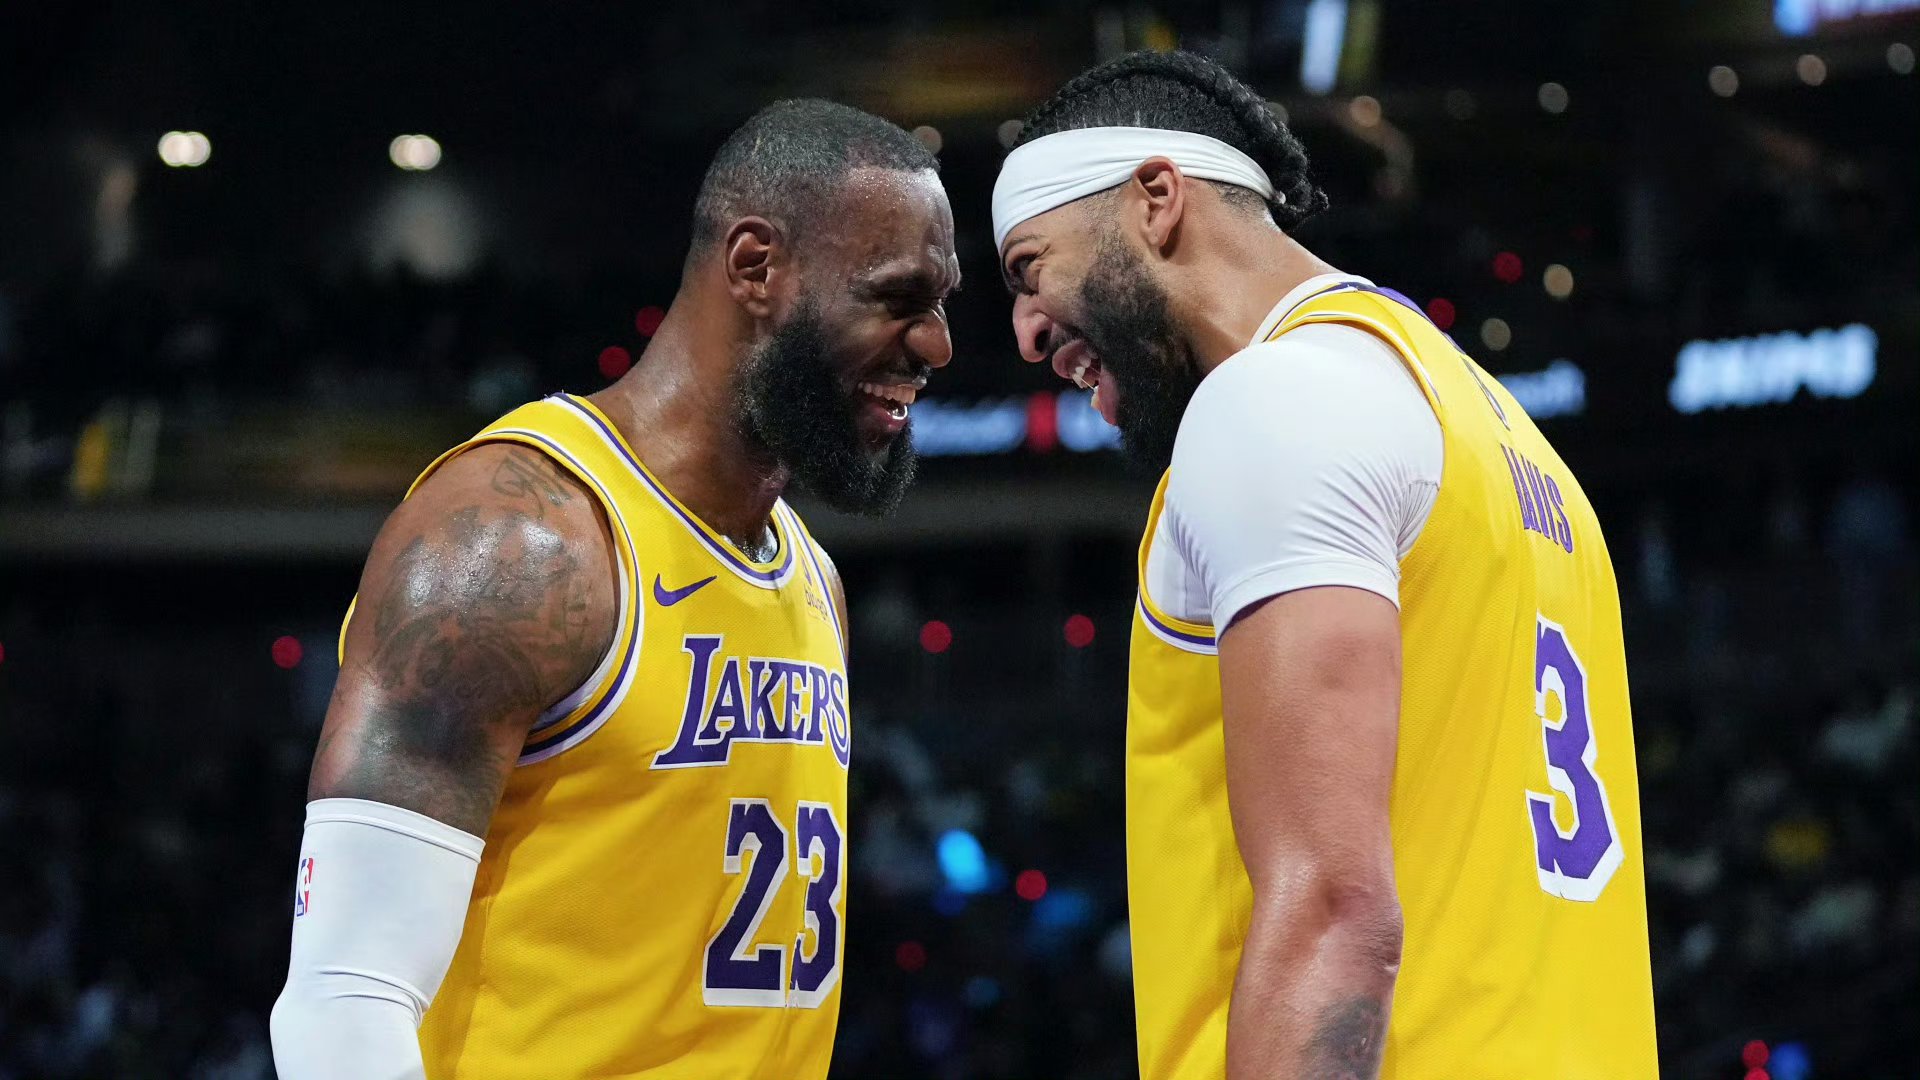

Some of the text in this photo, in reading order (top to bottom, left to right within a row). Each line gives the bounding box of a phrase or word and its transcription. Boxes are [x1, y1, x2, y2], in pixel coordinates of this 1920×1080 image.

[650, 634, 849, 770] LAKERS
[1526, 608, 1625, 902] 3
[703, 797, 843, 1008] 23
